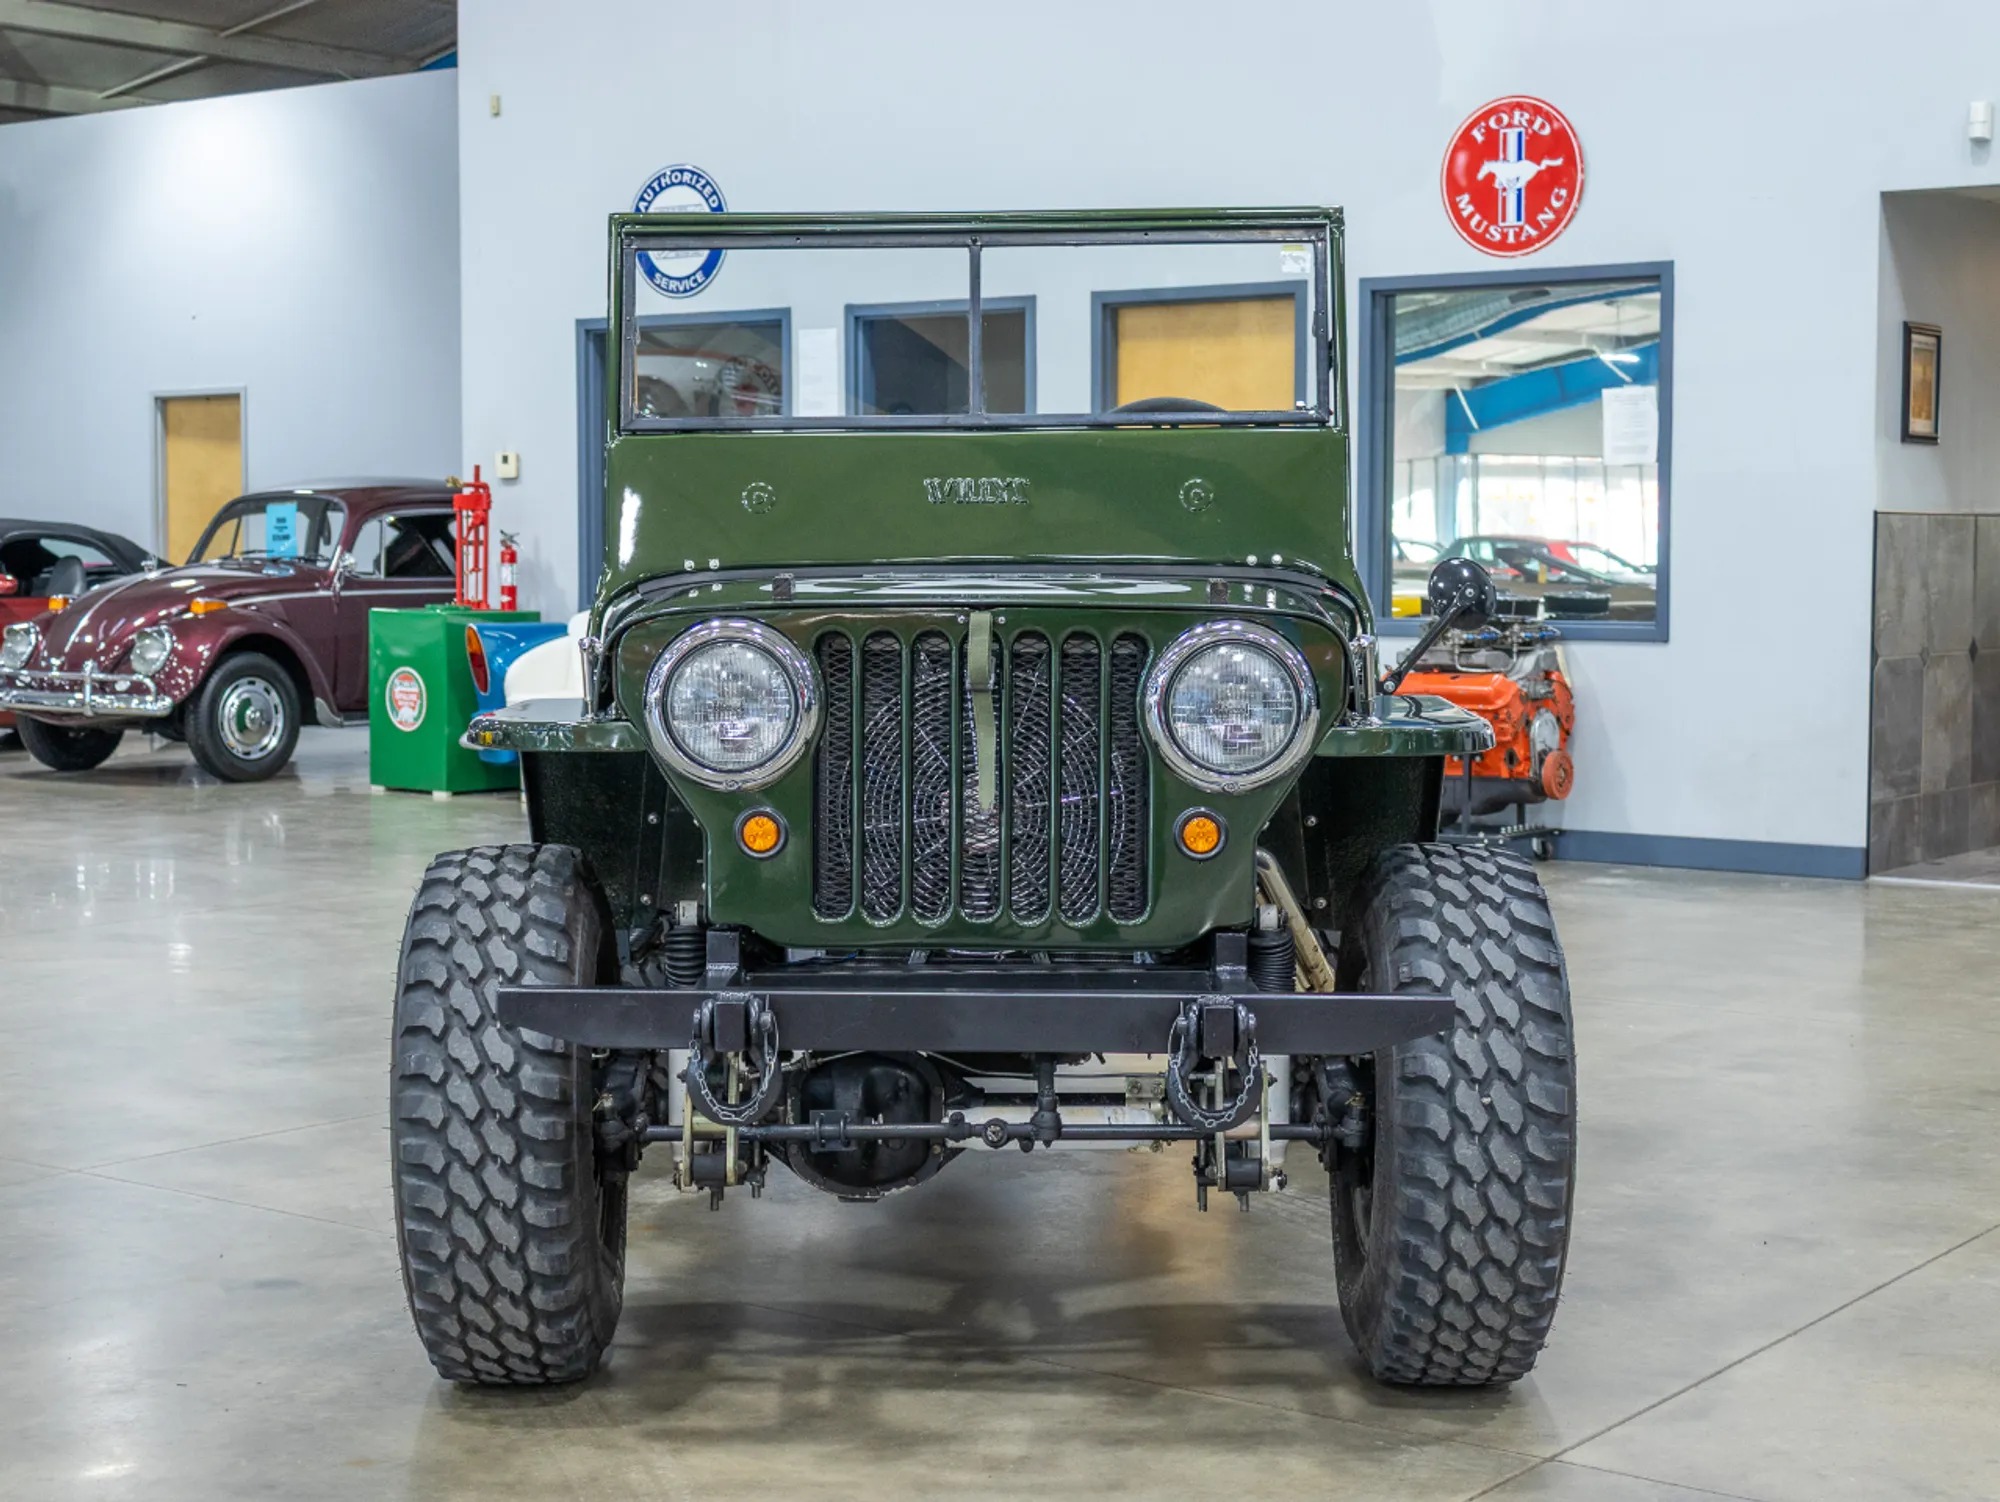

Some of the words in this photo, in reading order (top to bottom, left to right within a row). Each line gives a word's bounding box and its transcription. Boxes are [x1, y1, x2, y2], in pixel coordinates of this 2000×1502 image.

[1470, 110, 1552, 145] FORD
[638, 170, 720, 213] AUTHORIZED
[1455, 186, 1568, 244] MUSTANG
[653, 269, 707, 292] SERVICE
